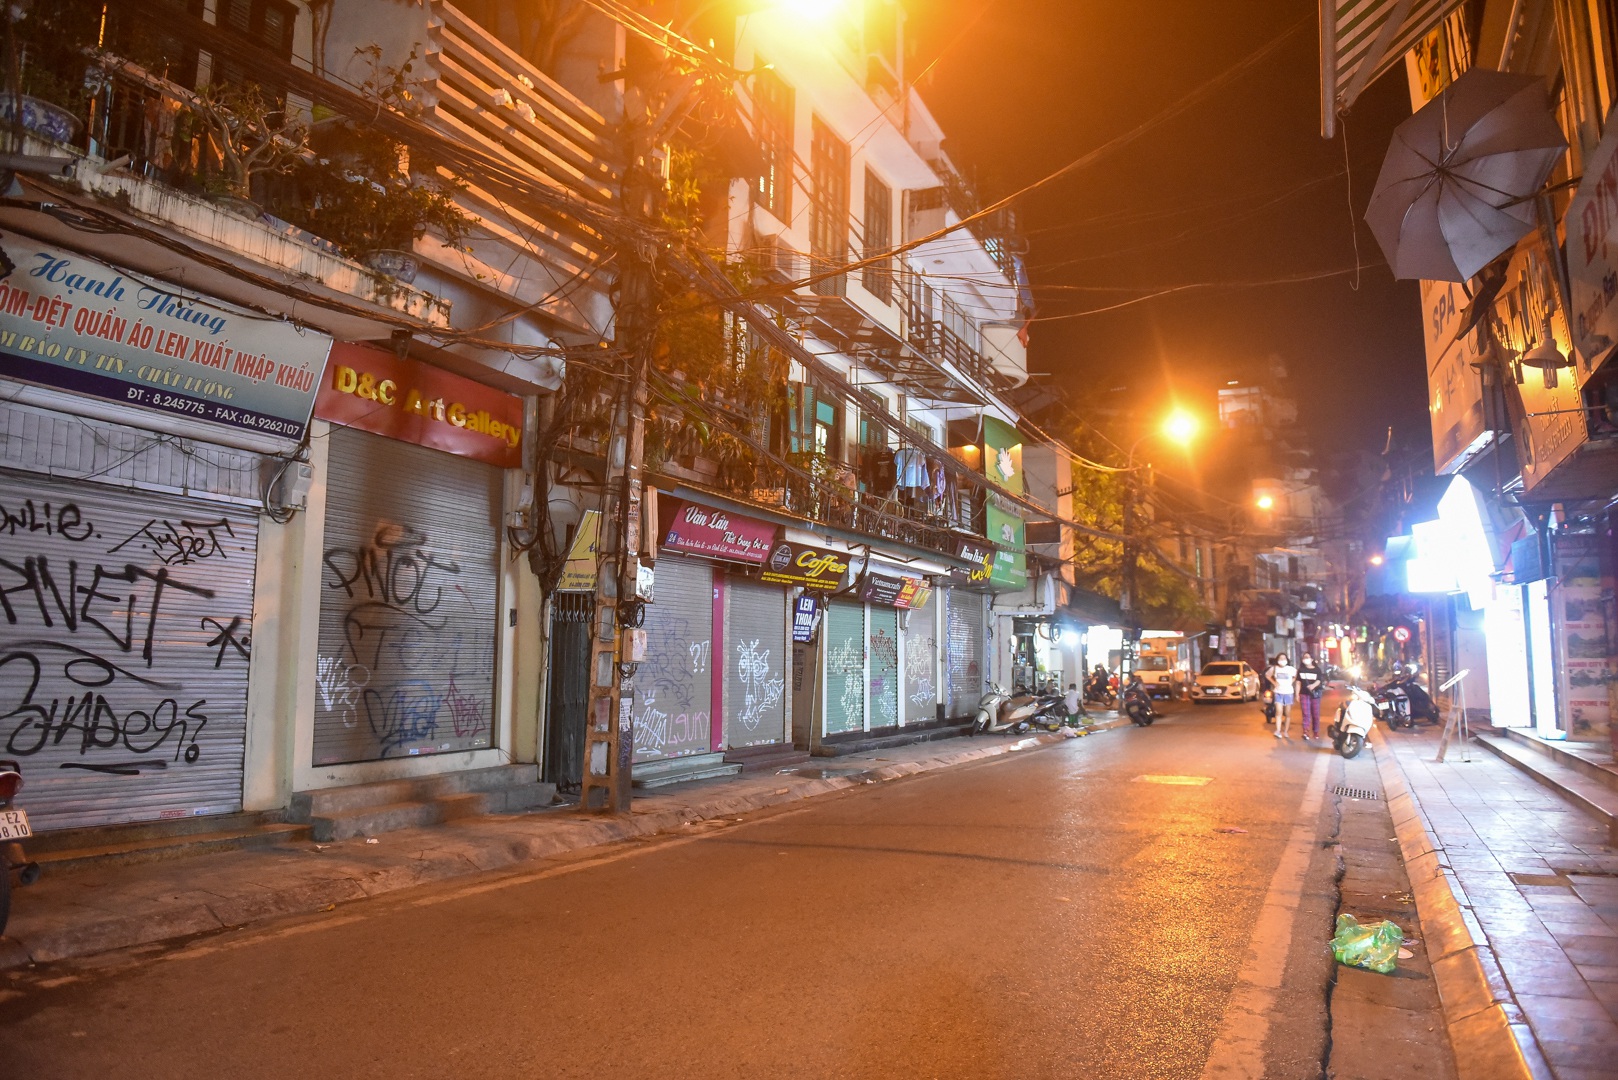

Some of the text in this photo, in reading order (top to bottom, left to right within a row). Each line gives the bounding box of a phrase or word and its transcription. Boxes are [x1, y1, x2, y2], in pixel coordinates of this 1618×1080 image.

[30, 252, 125, 302] Hạnh
[1433, 282, 1456, 343] SPA
[64, 346, 93, 365] UY
[95, 352, 128, 373] TÍN
[137, 364, 183, 391] CHẤT
[74, 306, 127, 342] QUẦN
[127, 319, 151, 349] ÁO
[155, 329, 186, 359] LEN
[190, 338, 233, 371] XUẤT
[232, 354, 274, 385] NHẬP
[276, 359, 314, 392] KHẨU
[127, 387, 144, 401] ĐT
[153, 393, 205, 414] 8.245775
[333, 365, 521, 448] D&C Art Gallery
[796, 550, 848, 577] Coffee
[796, 612, 812, 626] THOA
[800, 597, 813, 611] LEN
